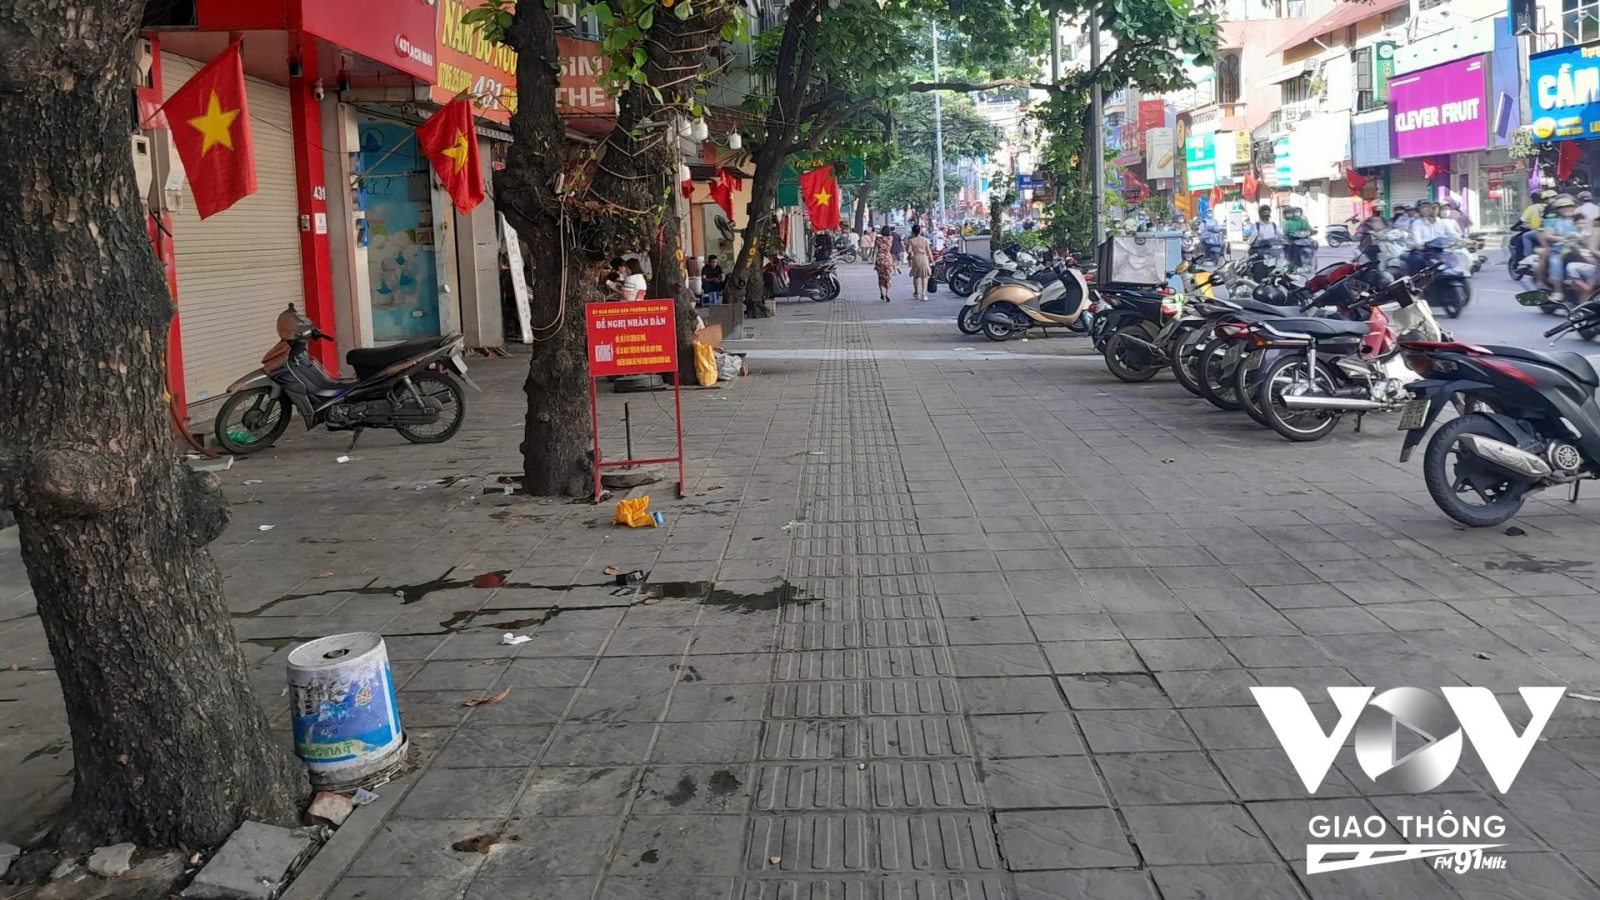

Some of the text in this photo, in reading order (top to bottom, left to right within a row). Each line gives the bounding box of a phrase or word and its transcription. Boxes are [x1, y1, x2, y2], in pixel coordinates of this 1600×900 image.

[473, 75, 502, 110] 431
[1395, 98, 1479, 132] KLEVER FRUIT
[314, 186, 325, 200] 431
[607, 319, 626, 329] NGHỊ
[627, 316, 649, 328] NHÂN
[650, 315, 666, 326] DÂN
